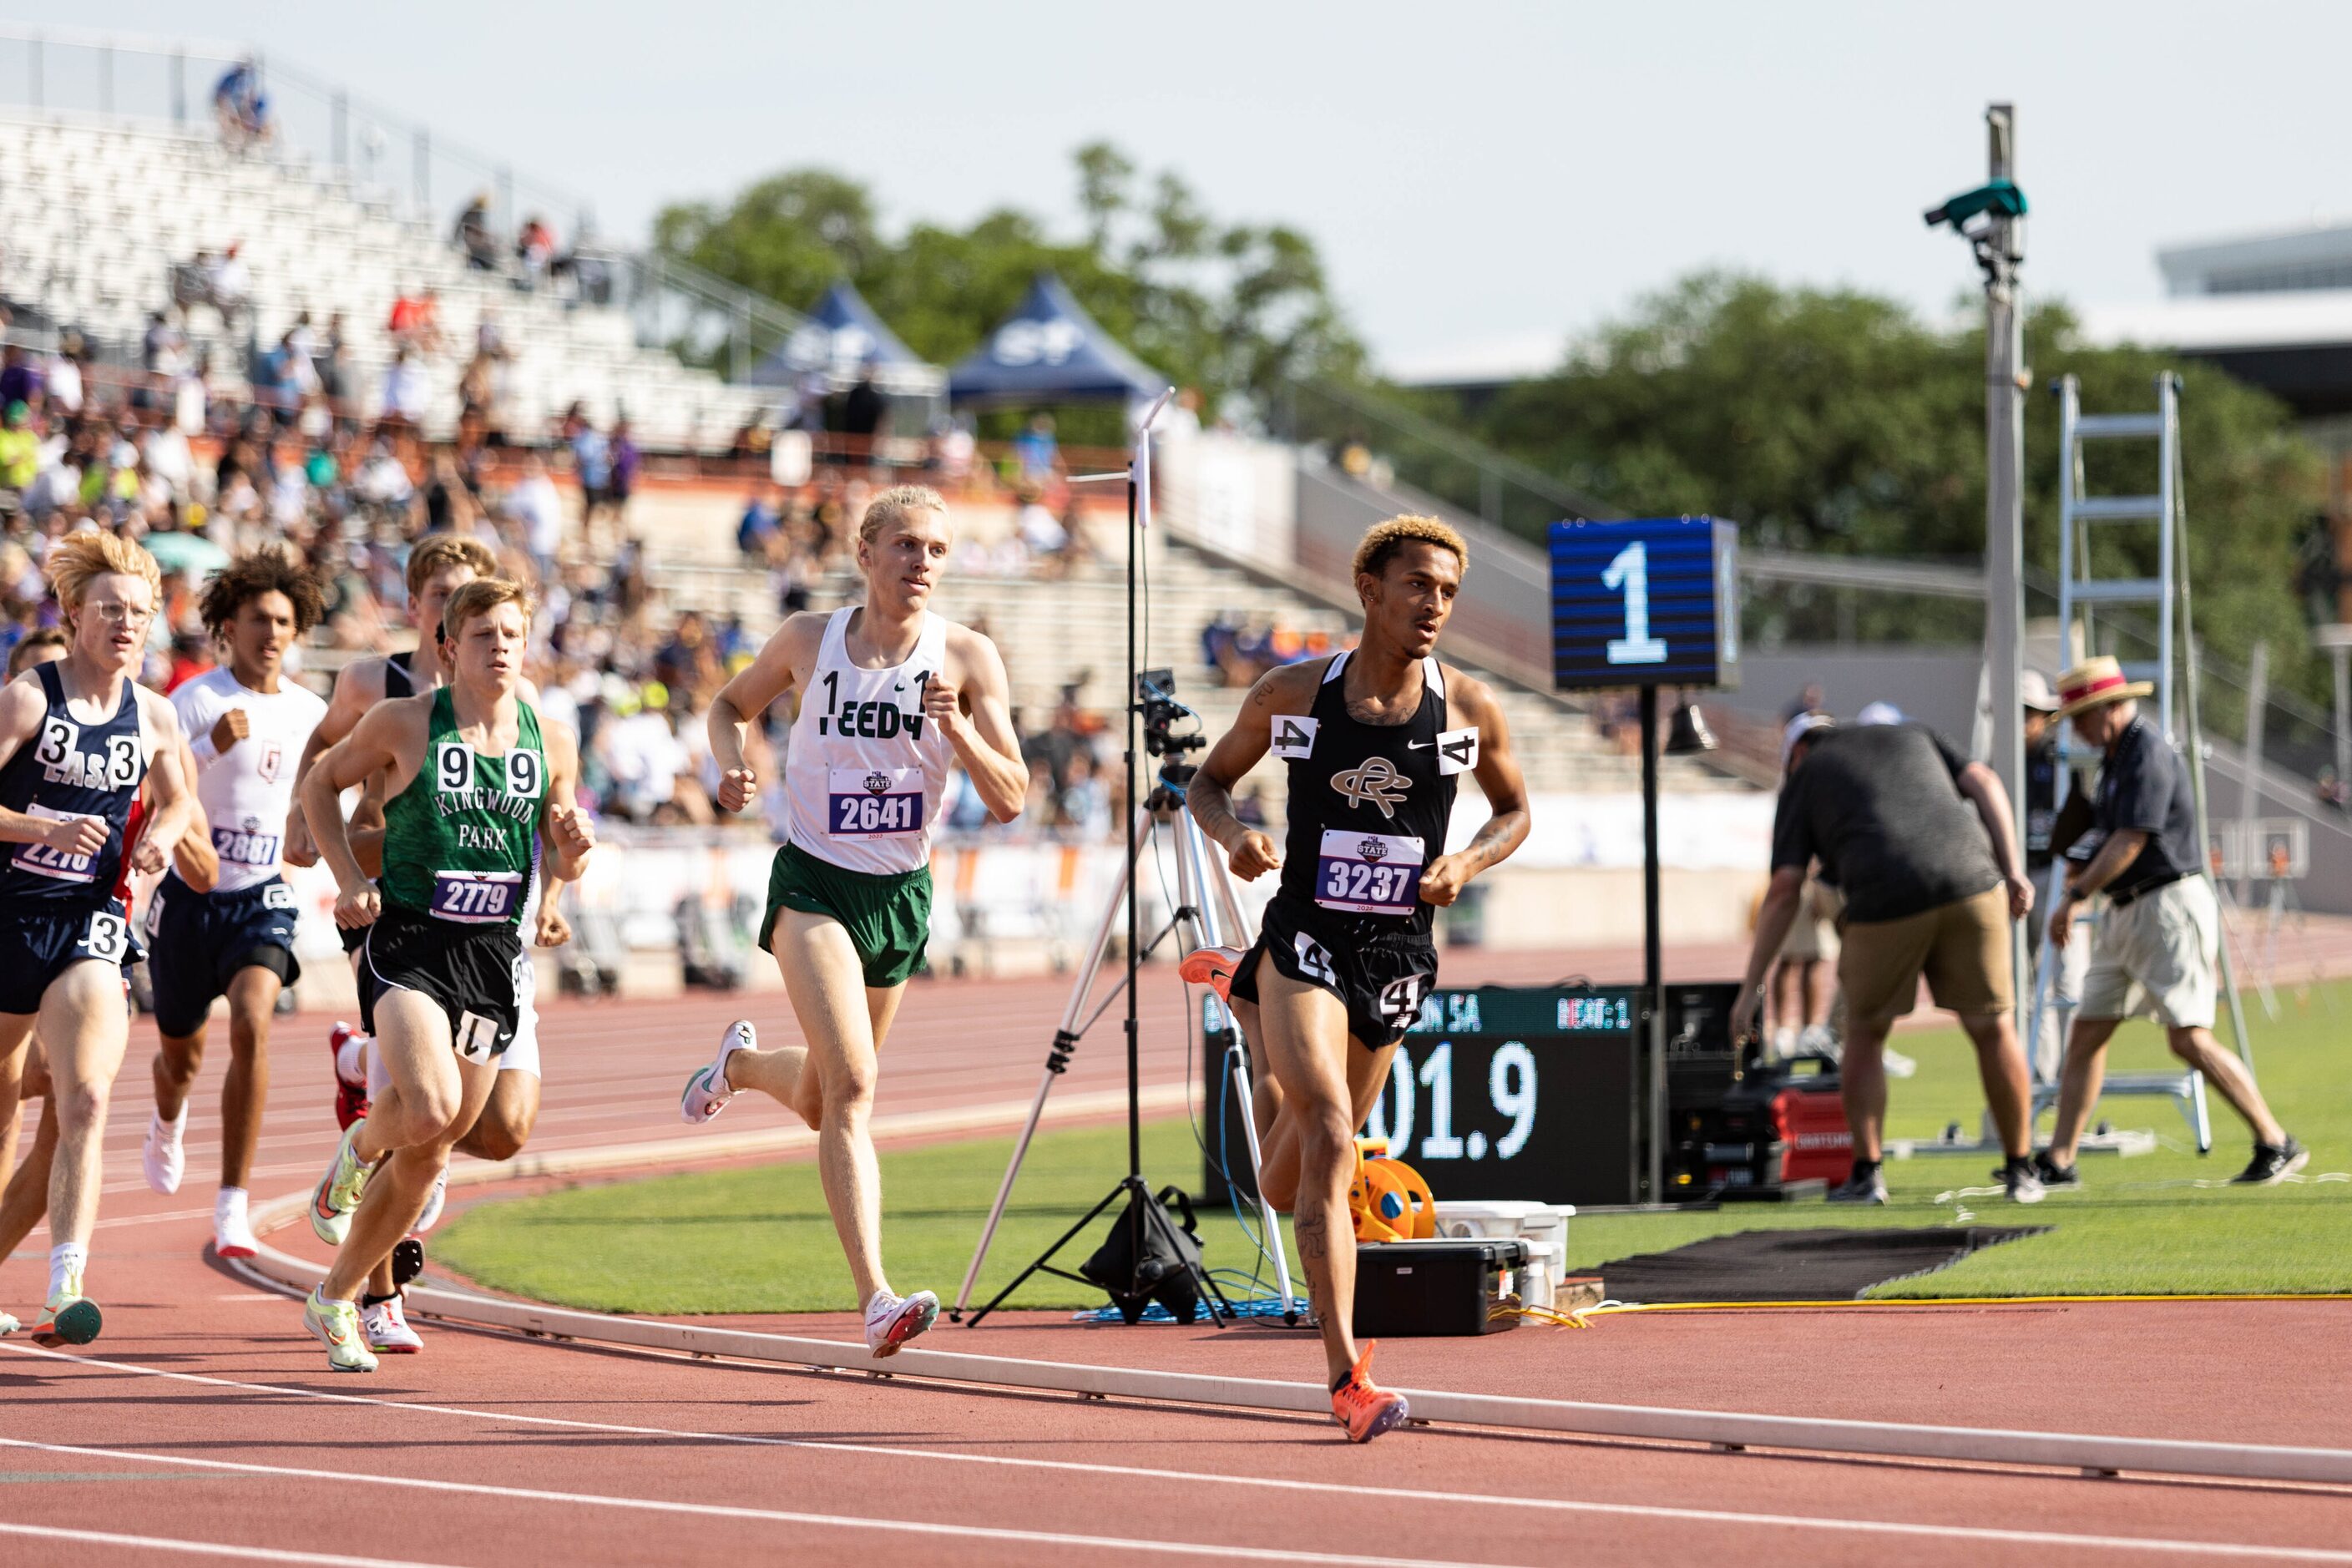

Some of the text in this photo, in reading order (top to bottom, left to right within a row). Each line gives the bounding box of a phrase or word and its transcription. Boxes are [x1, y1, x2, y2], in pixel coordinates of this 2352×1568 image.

[1601, 540, 1667, 664] 1
[823, 670, 838, 715] 1
[913, 670, 929, 713] 1
[42, 724, 70, 764] 3
[1274, 720, 1311, 751] 4
[1442, 736, 1474, 765] 4
[115, 741, 134, 781] 3
[443, 747, 468, 788] 9
[511, 753, 535, 793] 9
[434, 787, 534, 824] KINGWOOD
[840, 797, 912, 830] 2641
[458, 824, 508, 851] PARK
[1358, 845, 1388, 855] STATE
[443, 881, 508, 914] 2779
[1327, 862, 1410, 902] 3237
[94, 918, 117, 954] 3
[1304, 943, 1329, 980] 4
[1384, 980, 1411, 1012] 4
[1448, 994, 1482, 1032] 5A
[1557, 998, 1631, 1029] HEAT:1
